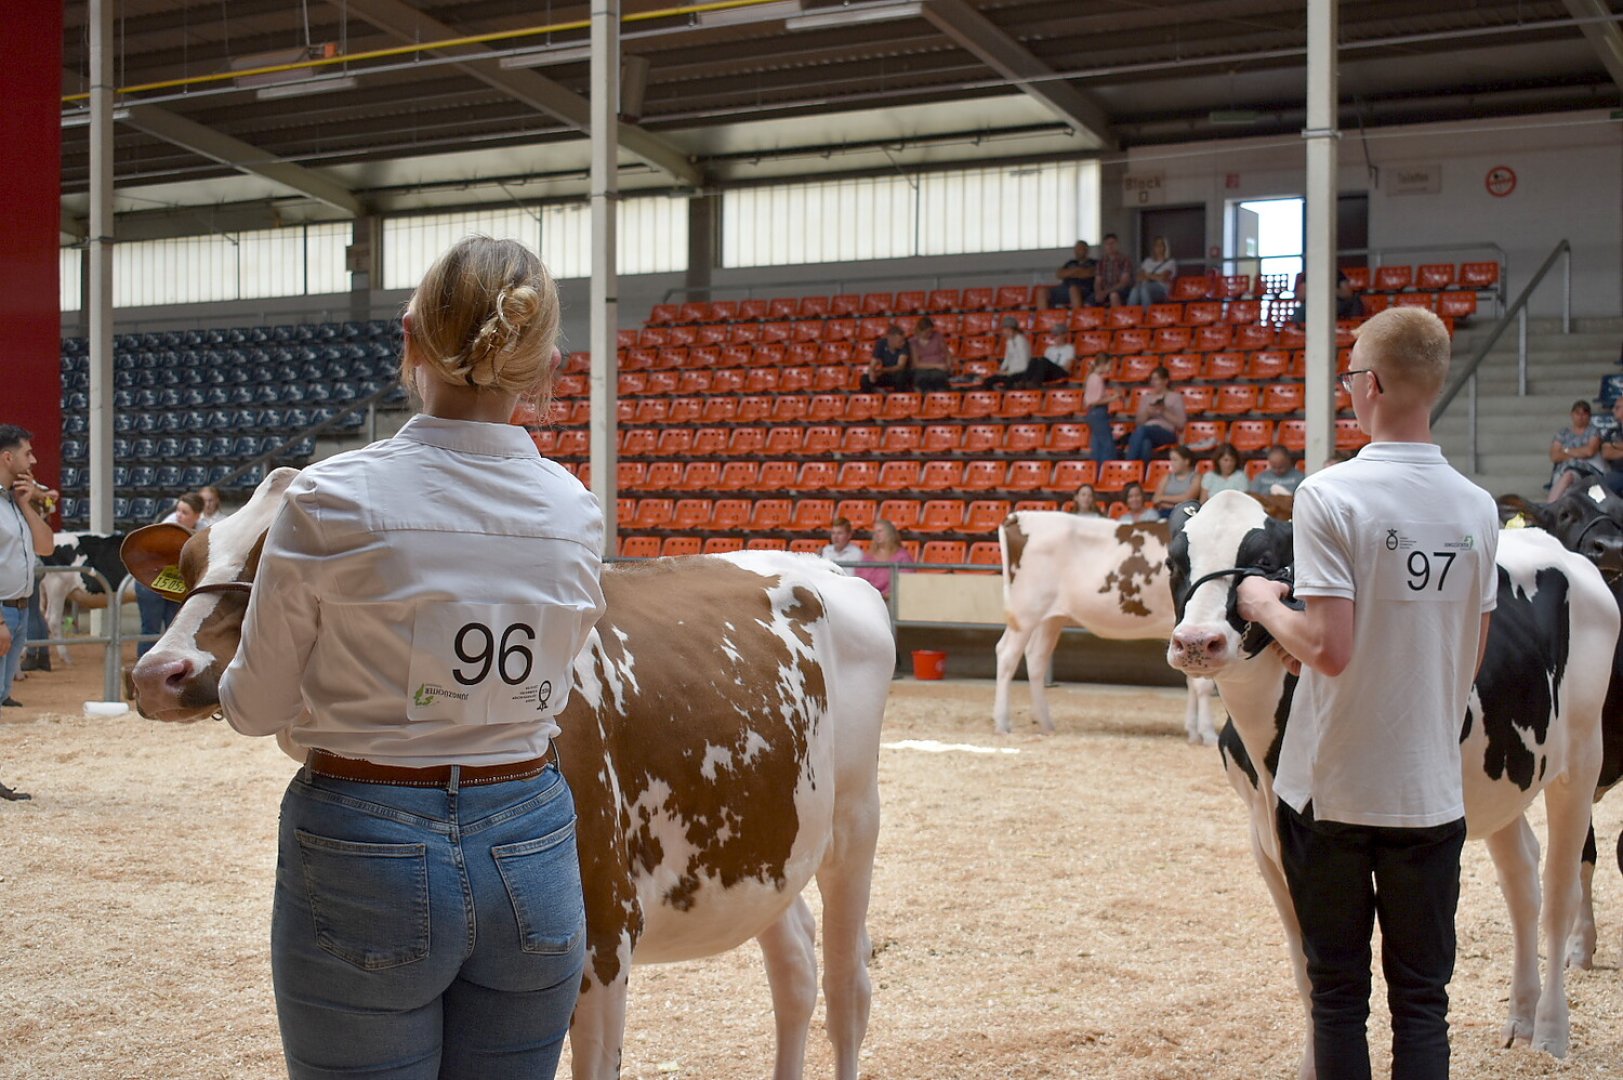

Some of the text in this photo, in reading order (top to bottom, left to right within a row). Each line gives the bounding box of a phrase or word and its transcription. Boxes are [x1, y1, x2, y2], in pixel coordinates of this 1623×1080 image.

[1125, 176, 1161, 190] Block
[1407, 550, 1457, 591] 97
[452, 622, 536, 686] 96
